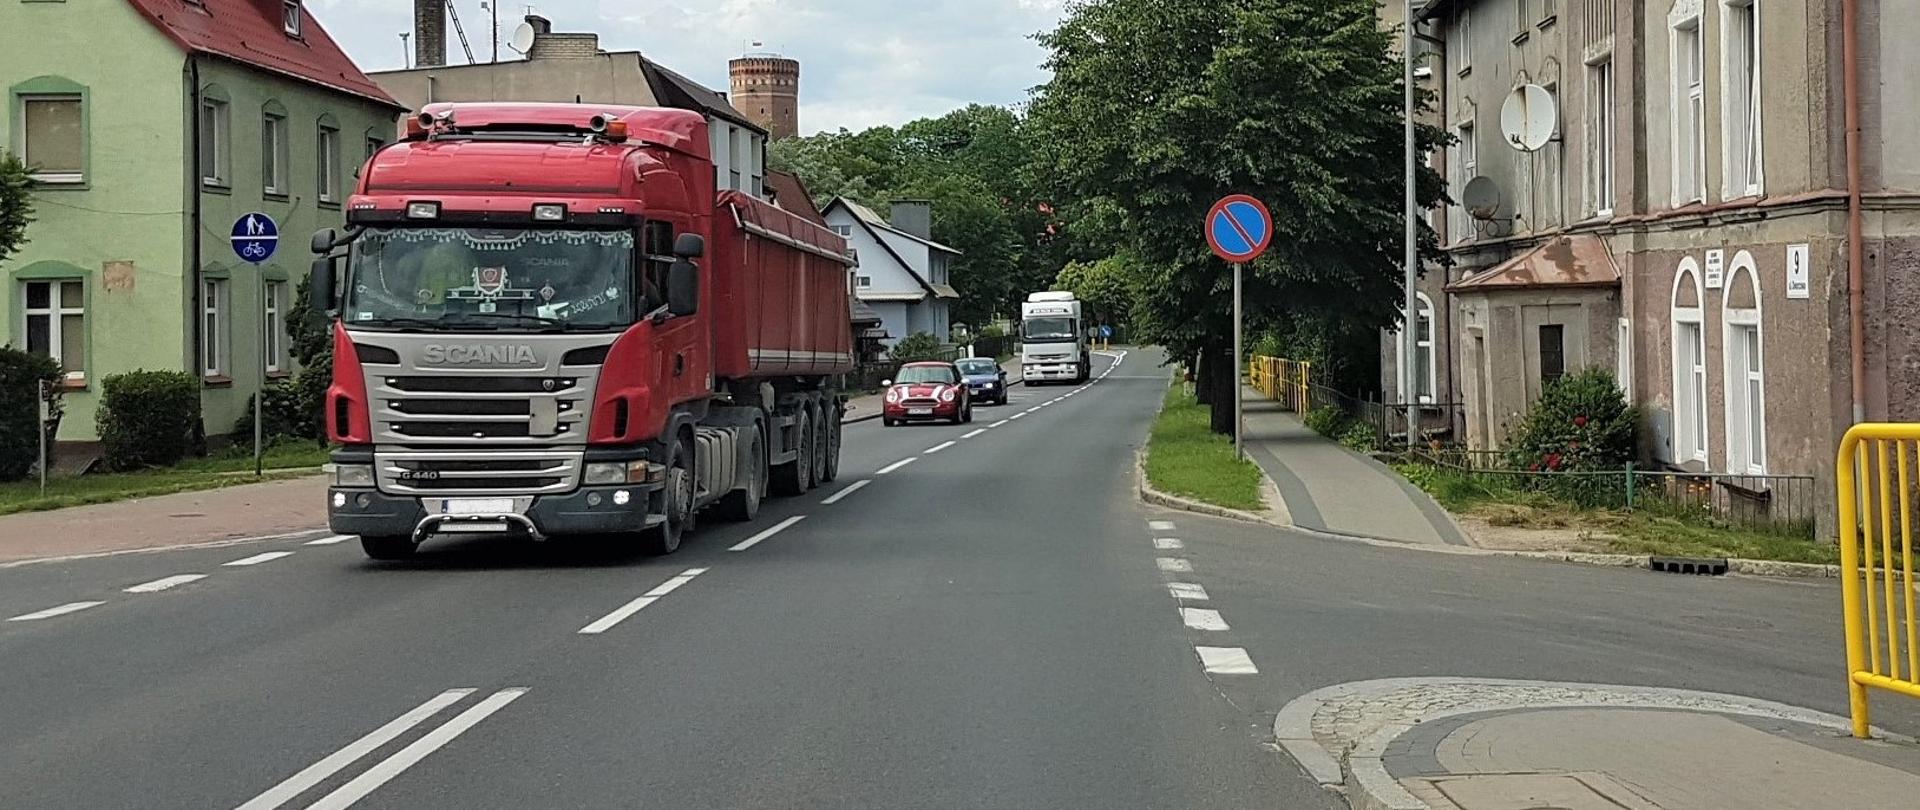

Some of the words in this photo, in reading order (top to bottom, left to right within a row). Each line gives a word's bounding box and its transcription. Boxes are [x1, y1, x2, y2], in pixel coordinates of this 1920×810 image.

[1794, 250, 1799, 275] 9
[424, 344, 537, 365] SCANIA
[402, 472, 411, 480] G
[412, 471, 437, 480] 440
